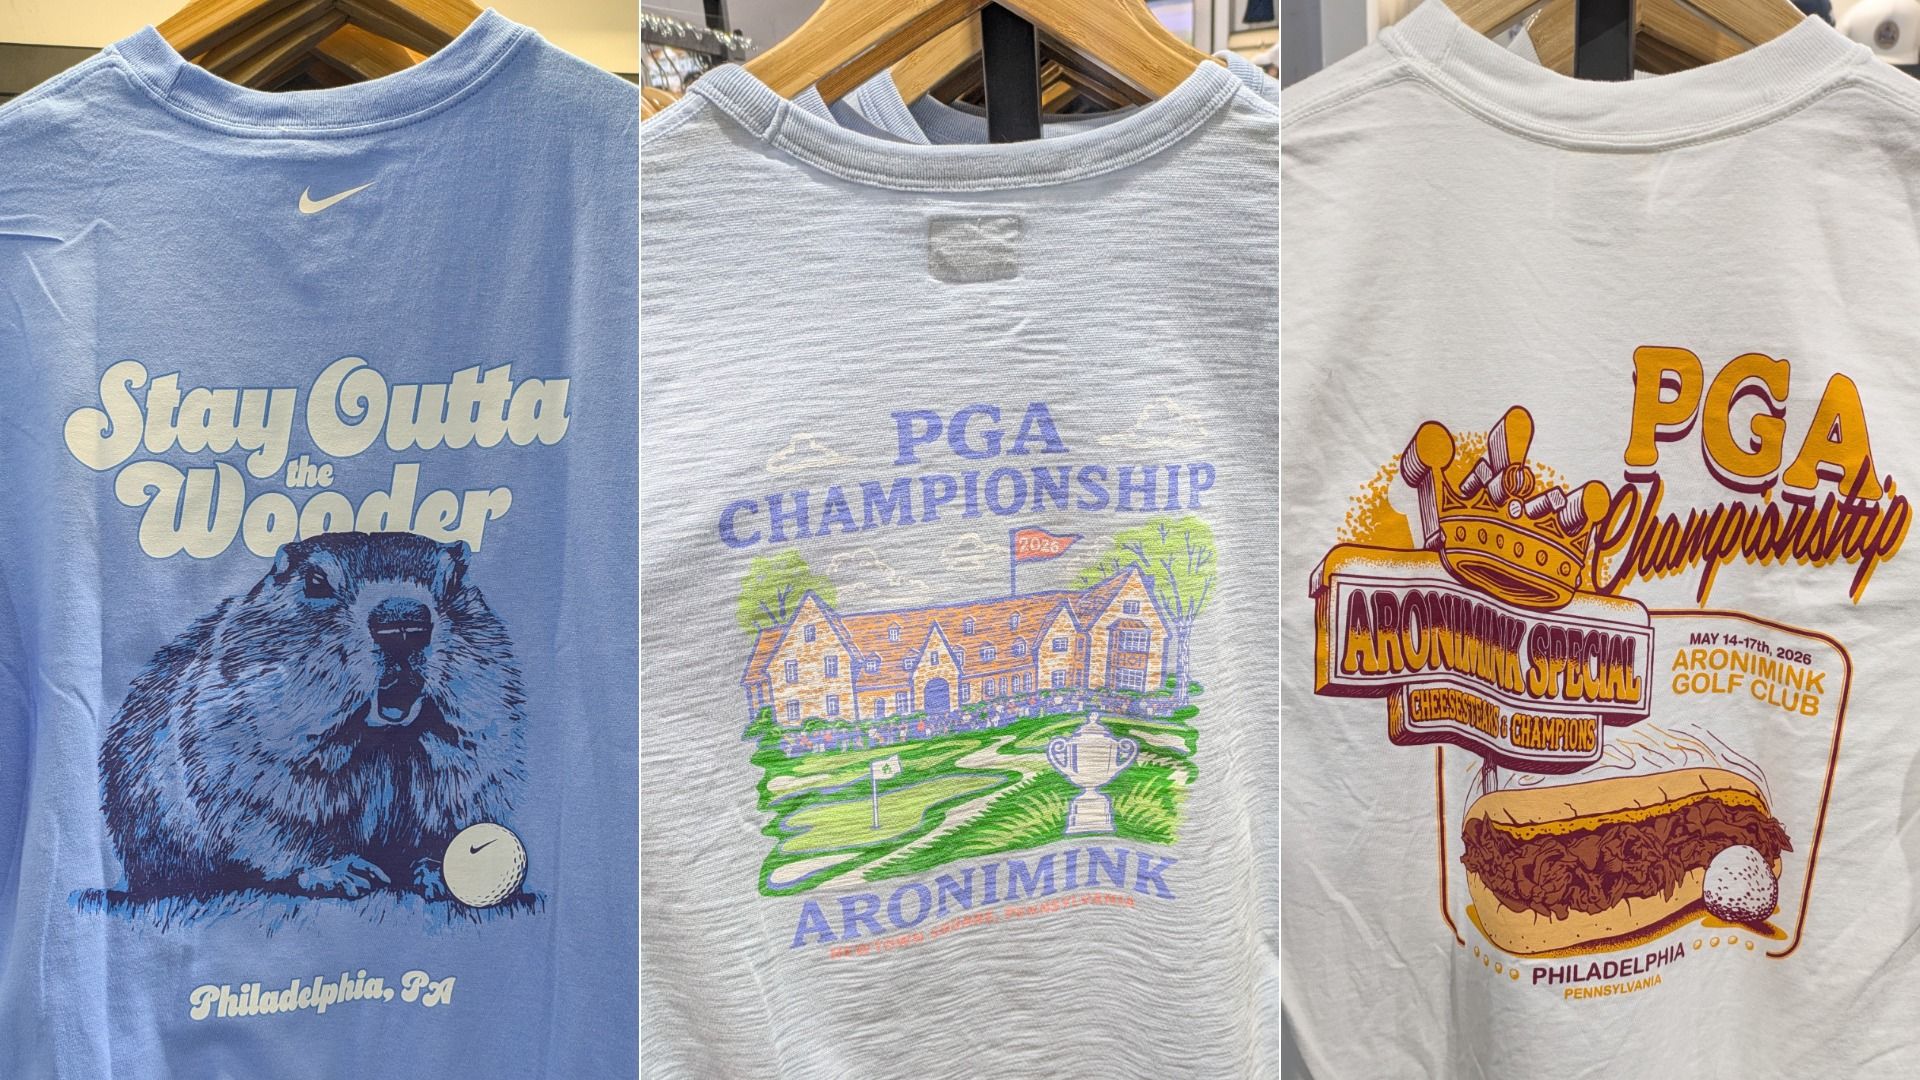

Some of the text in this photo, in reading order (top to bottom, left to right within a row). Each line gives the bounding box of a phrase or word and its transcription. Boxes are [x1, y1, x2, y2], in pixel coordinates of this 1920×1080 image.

[63, 356, 571, 478] Stay Outta
[889, 402, 1070, 466] PGA
[1624, 345, 1883, 502] PGA
[285, 454, 333, 488] the
[114, 460, 512, 558] Wooder
[718, 462, 1217, 549] CHAMPIONSHIP
[1592, 455, 1912, 608] Championship
[1019, 537, 1060, 553] 2026
[1341, 589, 1642, 703] ARONIMINK SPECIAL
[1672, 648, 1825, 694] ARONIMINK
[1690, 633, 1812, 665] MAY 14-17th, 2026
[1410, 688, 1500, 738] CHEESESTEAKS
[1511, 713, 1597, 752] CHAMPIONS
[1672, 673, 1819, 716] GOLF CLUB
[790, 847, 1178, 949] ARONIMINK
[190, 969, 456, 1020] Philadelphia, PA
[1532, 942, 1685, 985] PHILADELPHIA
[1564, 974, 1662, 1000] PENNSYLVANIA
